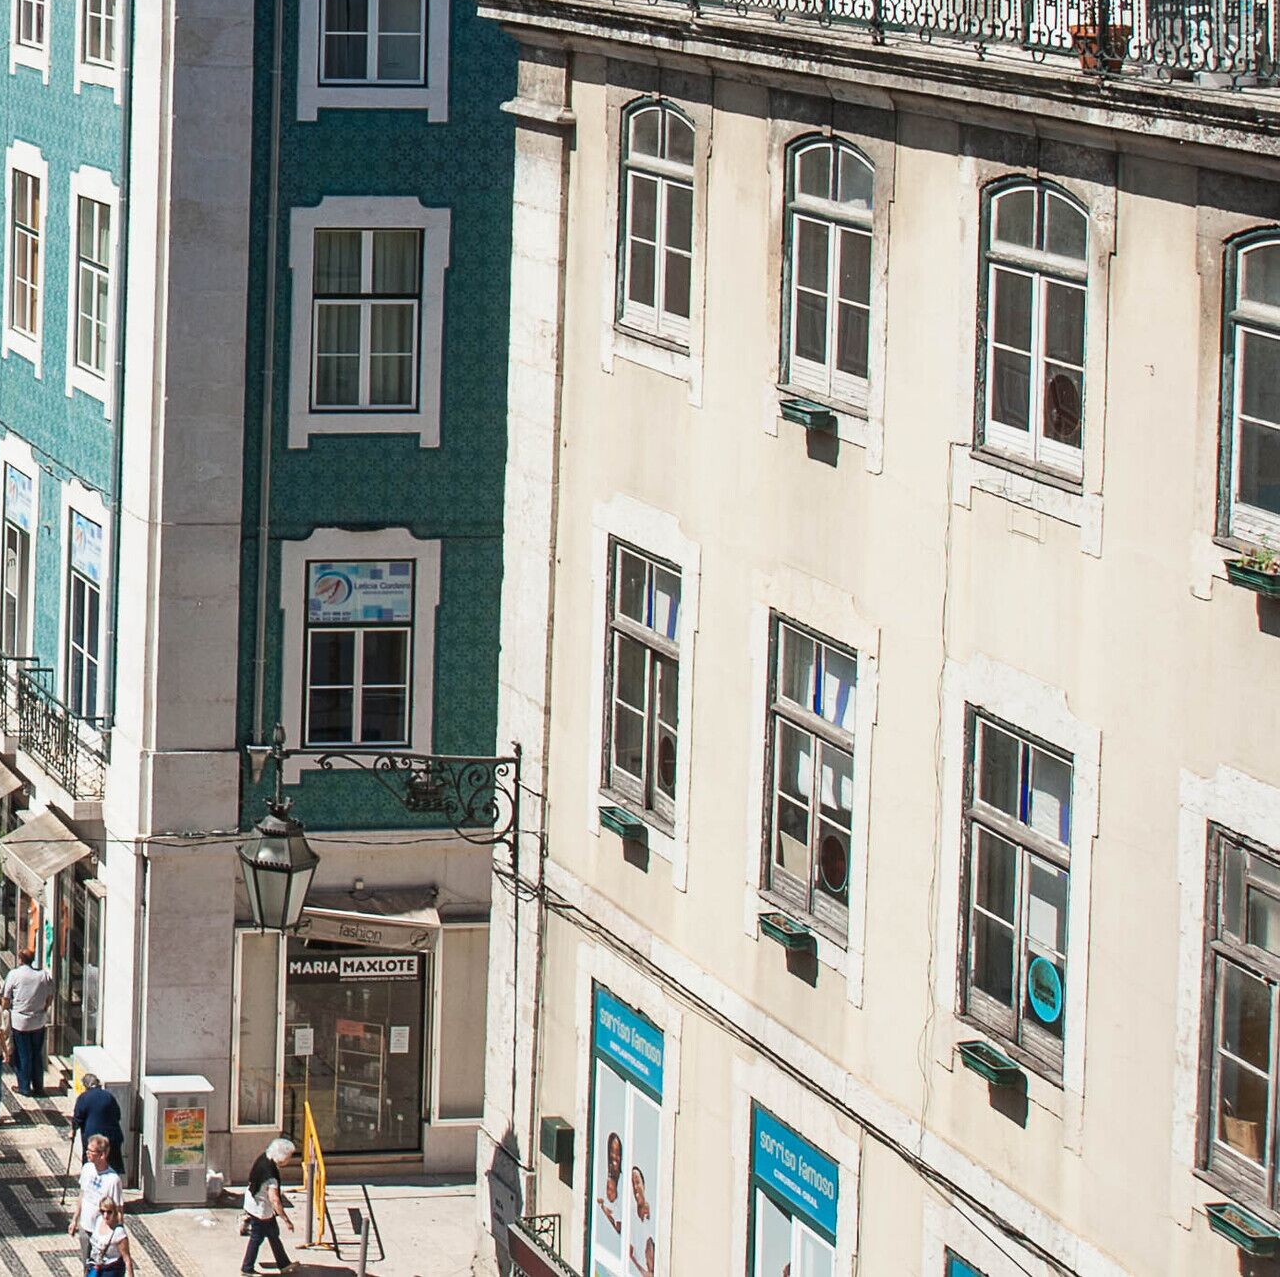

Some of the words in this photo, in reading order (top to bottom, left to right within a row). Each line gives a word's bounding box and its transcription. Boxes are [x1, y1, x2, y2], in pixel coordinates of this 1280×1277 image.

[339, 922, 382, 940] fashion
[289, 961, 339, 974] MARIA
[343, 959, 415, 973] MAXLOTE
[600, 1007, 631, 1044] sorriso
[631, 1027, 662, 1067] famoso
[760, 1130, 796, 1171] sorriso
[798, 1155, 834, 1200] famoso
